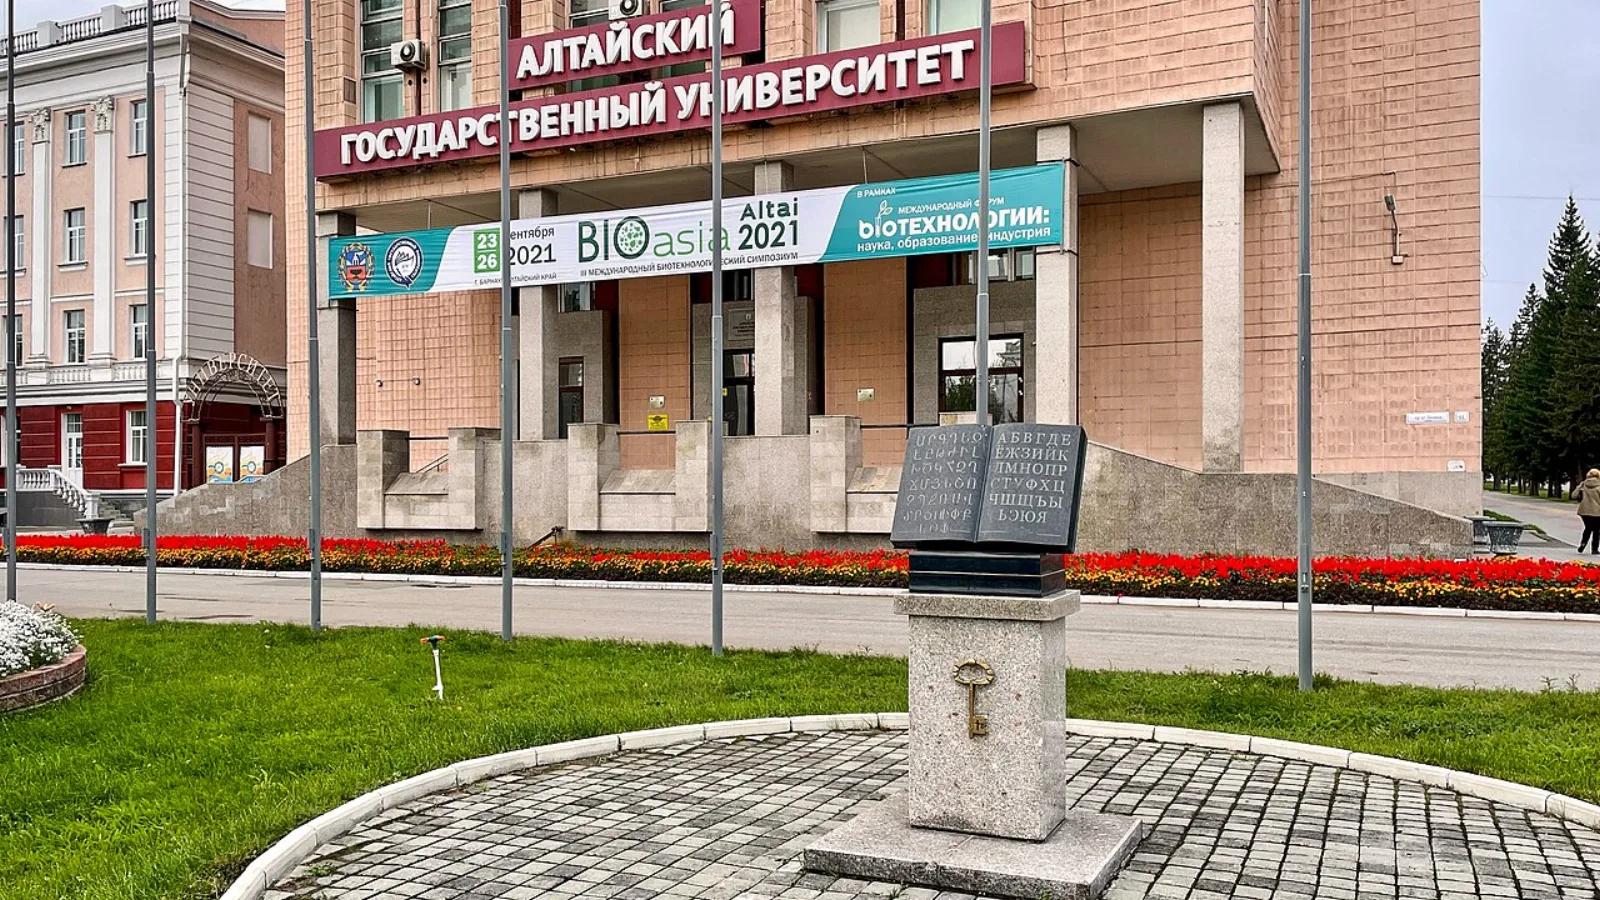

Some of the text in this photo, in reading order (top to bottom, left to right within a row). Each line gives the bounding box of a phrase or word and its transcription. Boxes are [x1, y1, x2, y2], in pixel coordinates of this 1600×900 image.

[516, 1, 735, 80] АЛТАЙСКИЙ
[341, 39, 975, 165] ГОСУДАРСТВЕННЫЙ УНИВЕРСИТЕТ
[856, 187, 897, 198] В РАМКАХ
[739, 197, 799, 221] Altai
[898, 199, 972, 215] МЕЖДУНАРОДНЫЙ
[477, 233, 498, 250] 23
[508, 225, 556, 241] ентября
[738, 219, 799, 251] 2021
[508, 243, 557, 266] 2021
[857, 240, 895, 253] наука,
[477, 253, 498, 270] 26
[588, 262, 656, 277] МЕЖДУНАРОДНЫЙ
[656, 254, 746, 271] БИОТЕХНОЛОГИЕСКИЙ
[747, 251, 799, 264] СИМПОЗИУМ
[997, 432, 1071, 447] АБВГДЕ
[994, 445, 1069, 461] ЁЖЗИЙК
[994, 461, 1068, 476] ЛМНОПР
[990, 477, 1065, 494] СТУФХЦ
[989, 493, 1063, 509] ЧШЩЪЫ
